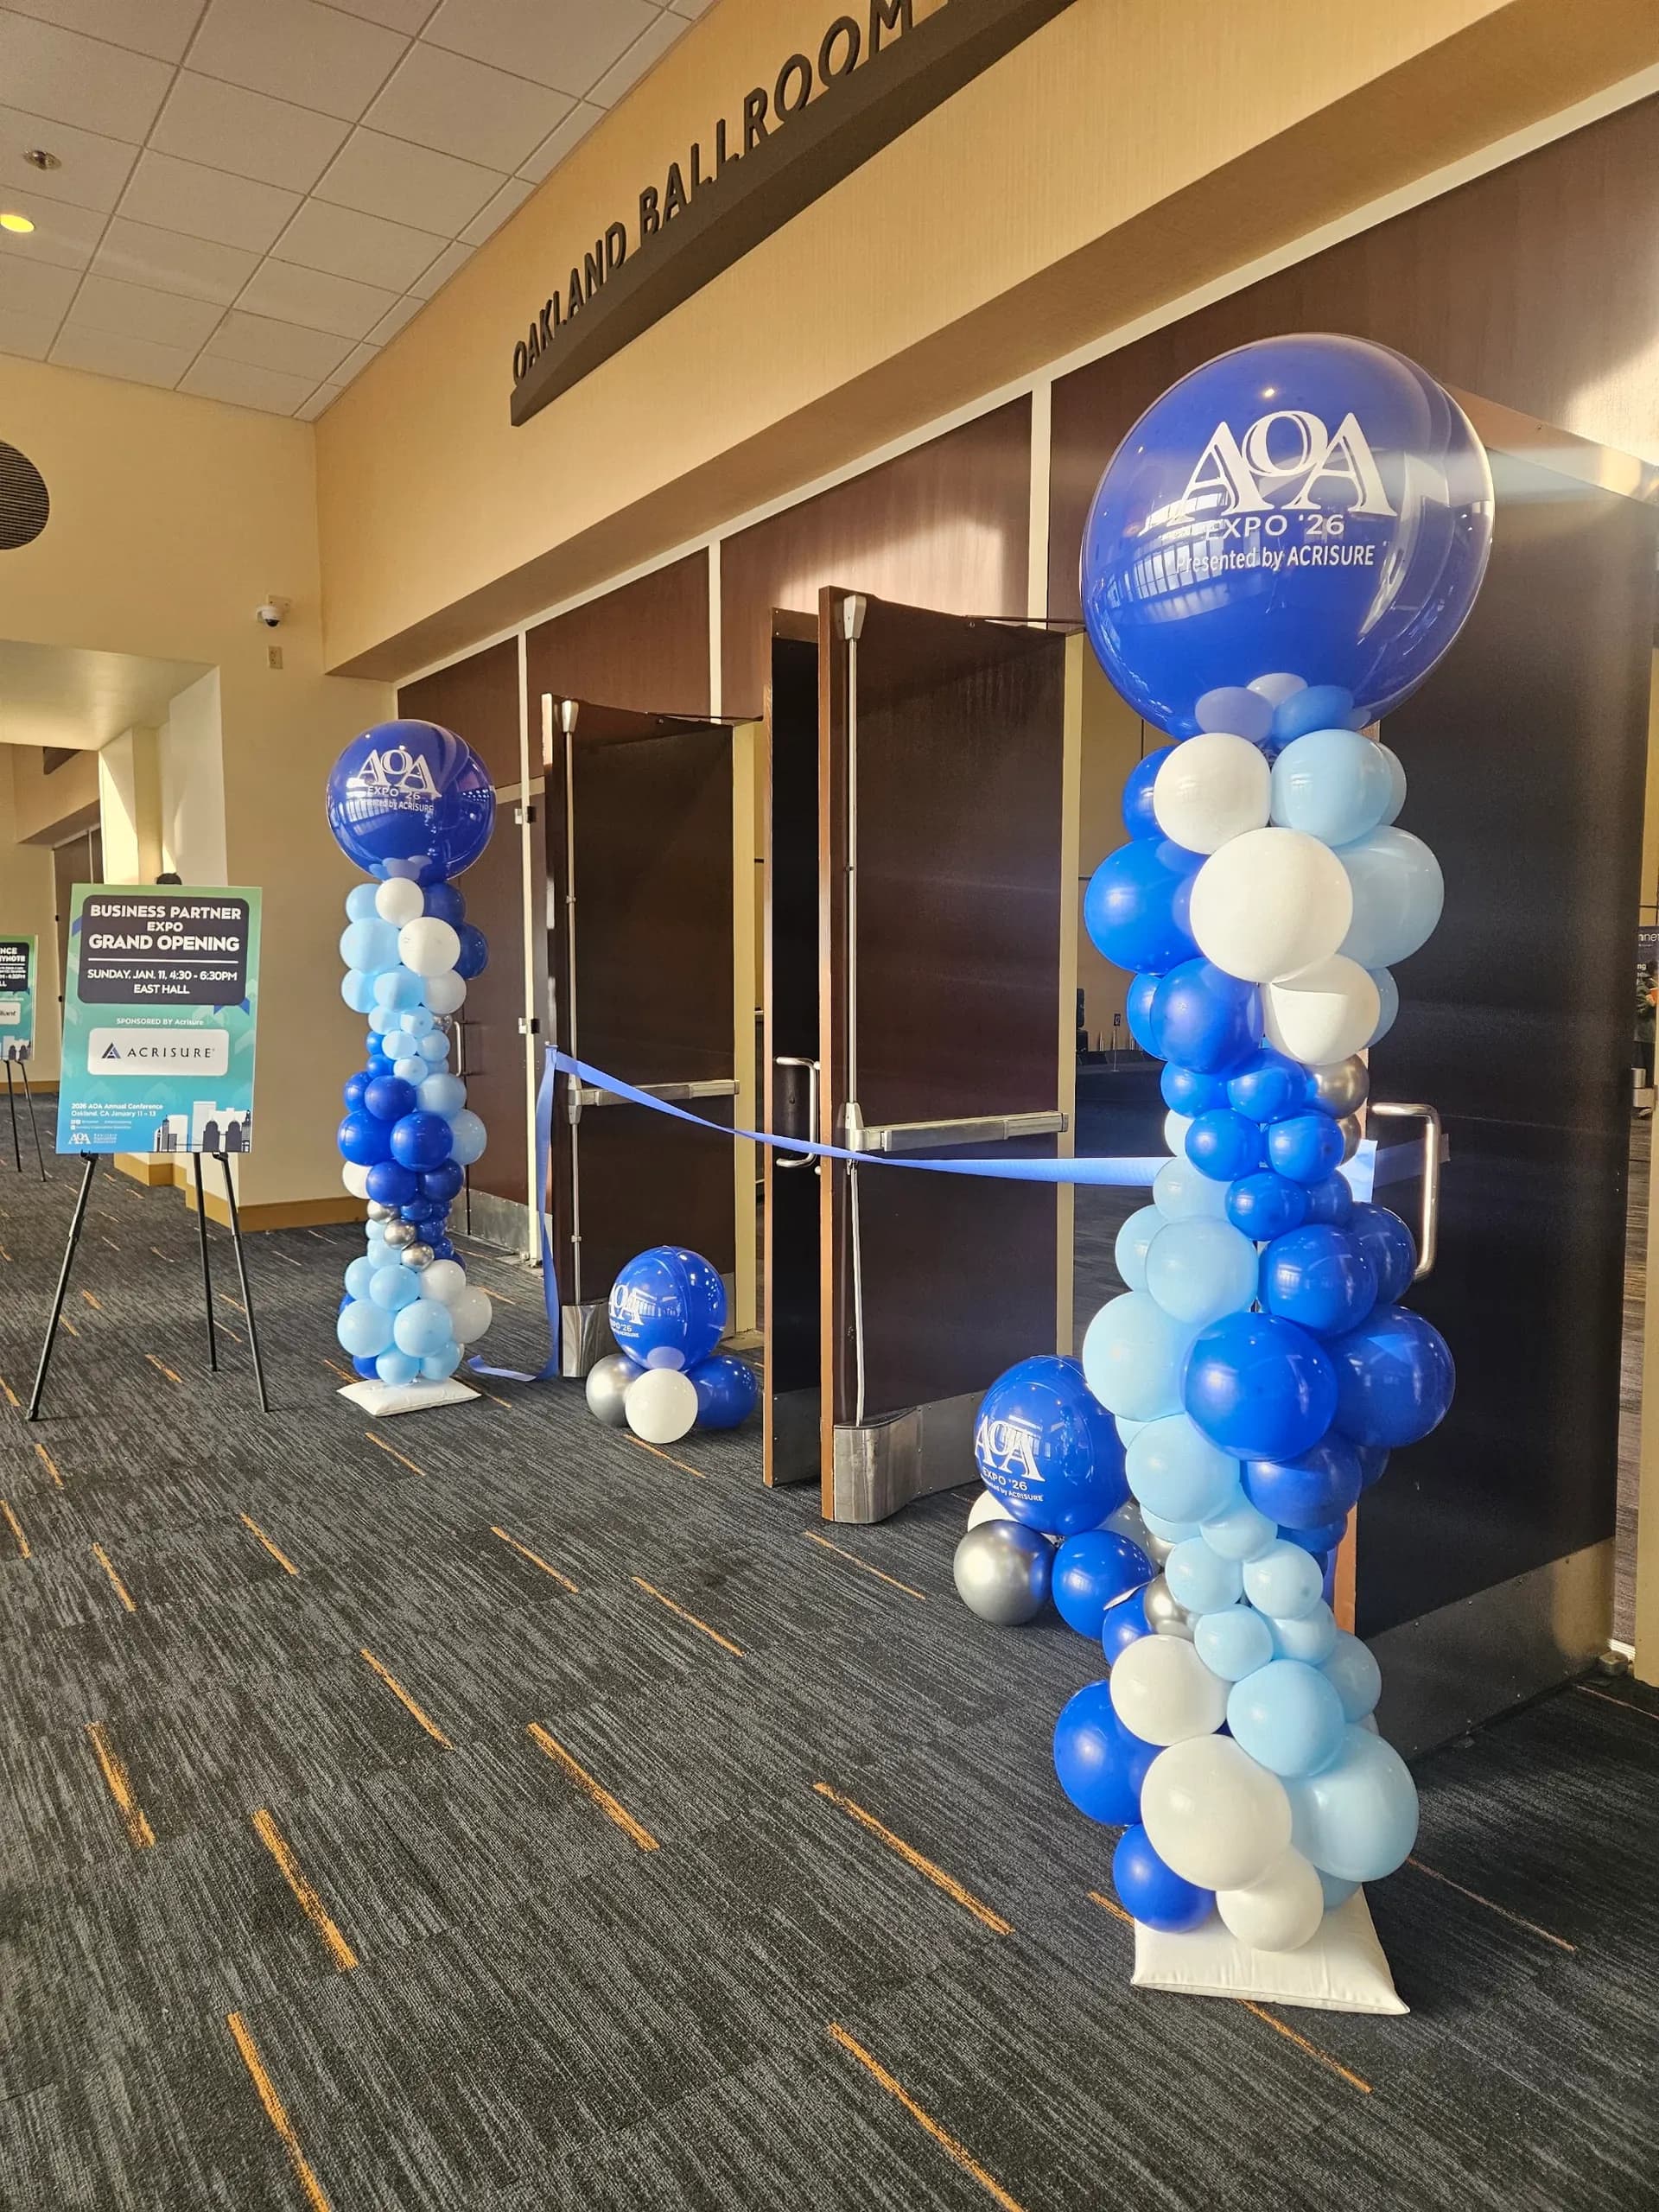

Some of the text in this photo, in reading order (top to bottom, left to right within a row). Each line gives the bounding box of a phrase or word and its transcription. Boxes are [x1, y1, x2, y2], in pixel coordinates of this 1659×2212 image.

[513, 0, 913, 387] OAKLAND BALLROOM
[1167, 410, 1397, 527] AOA
[1205, 513, 1344, 540] EXPO '26
[1176, 544, 1376, 573] Presented by ACRISURE
[356, 749, 442, 798] AOA
[367, 786, 421, 800] EXPO 26
[90, 905, 242, 920] BUSINESS PARTNER
[146, 921, 184, 932] EXPO
[88, 933, 240, 952] GRAND OPENING
[87, 969, 131, 980] SUNDAY,
[132, 970, 156, 980] JAN.
[169, 971, 192, 981] 4:30
[200, 971, 238, 981] 6:30PM
[134, 984, 190, 995] EAST HALL
[117, 1017, 161, 1026] SPONSORED
[175, 1018, 204, 1027] Acrisure
[127, 1047, 212, 1058] ACRISURE
[68, 1133, 91, 1144] AOA
[975, 1414, 1046, 1482] AOA
[982, 1466, 1007, 1485] EXPO
[1008, 1478, 1028, 1491] '26
[1008, 1490, 1045, 1502] ACRISURE
